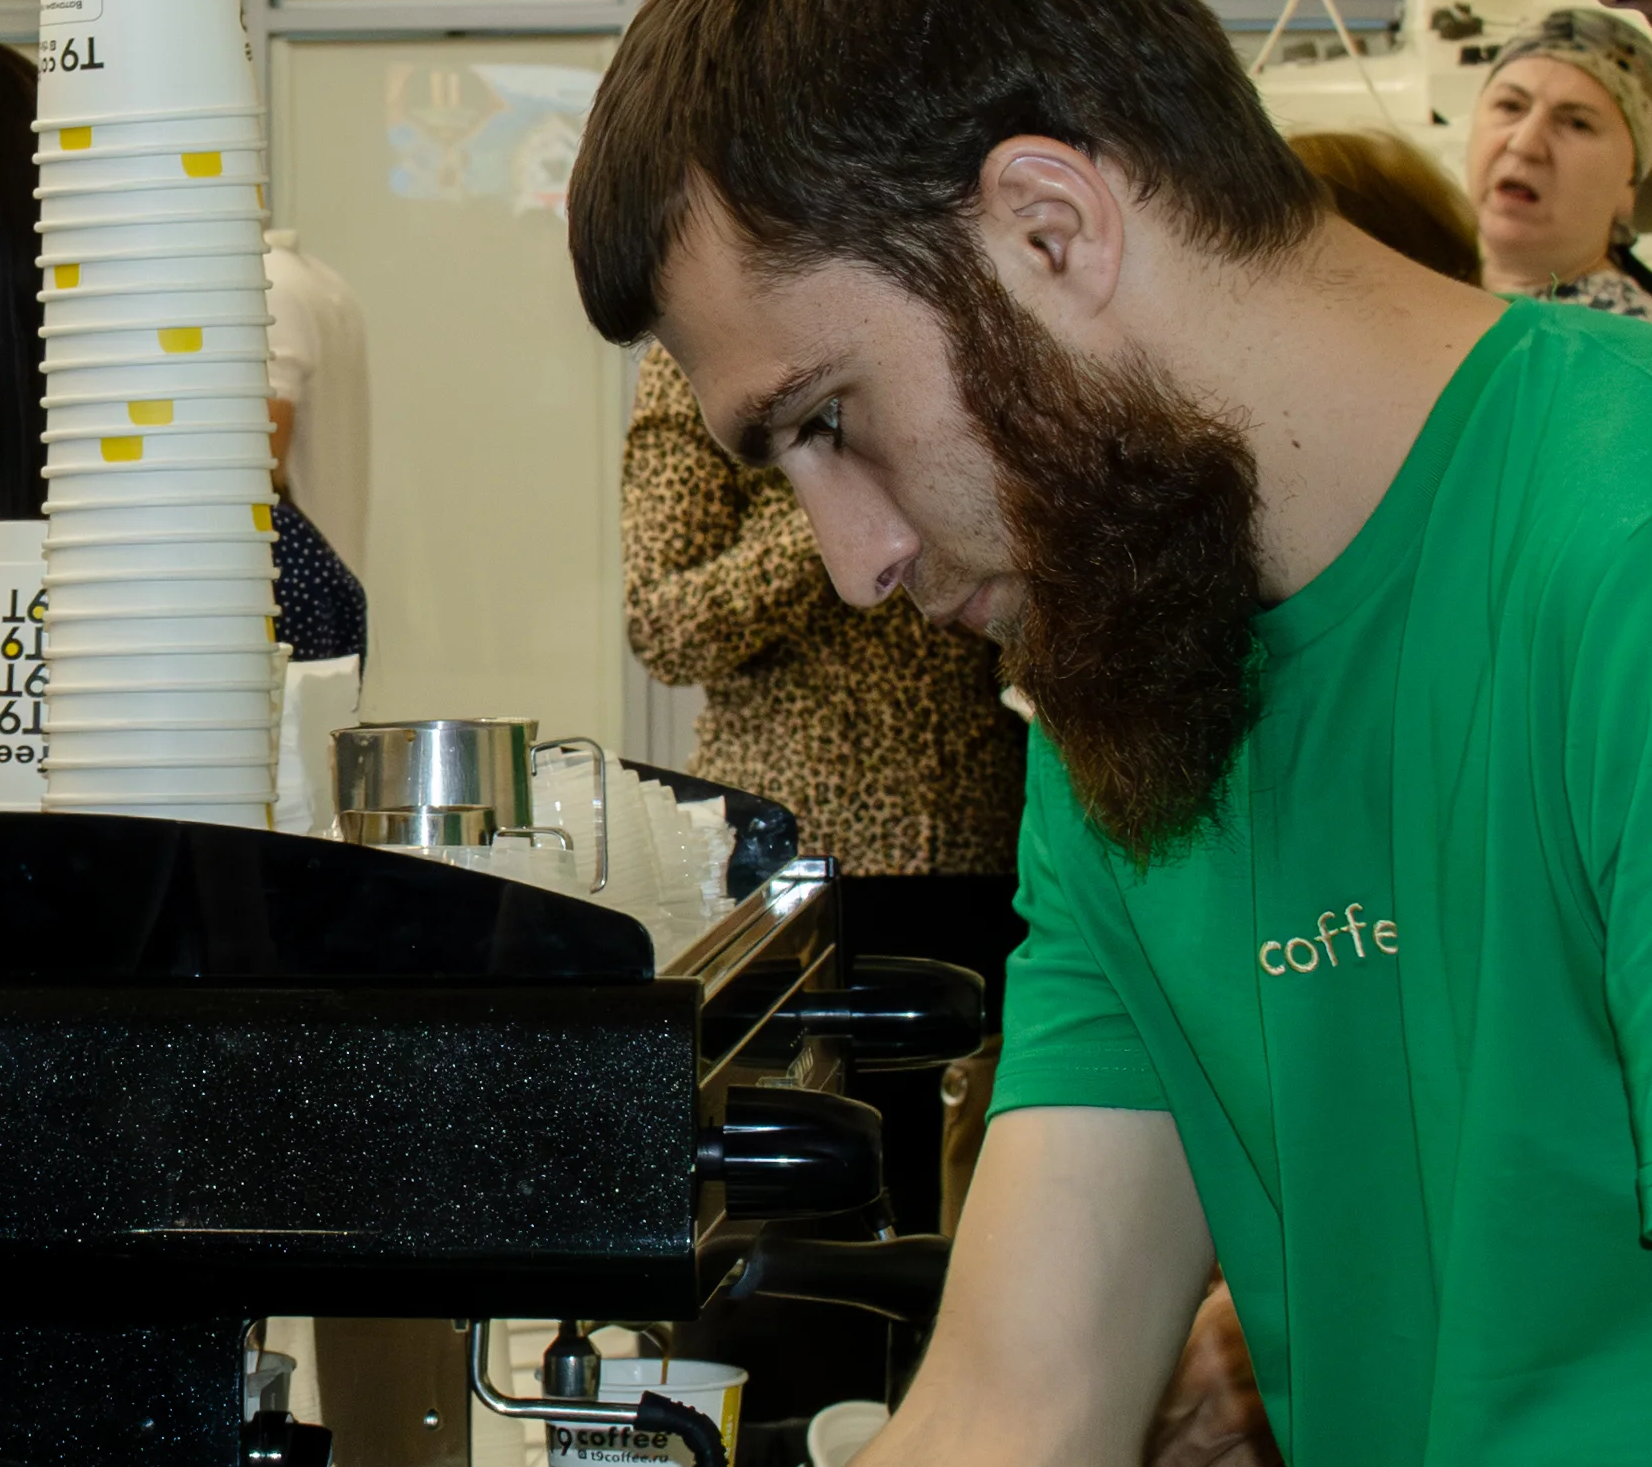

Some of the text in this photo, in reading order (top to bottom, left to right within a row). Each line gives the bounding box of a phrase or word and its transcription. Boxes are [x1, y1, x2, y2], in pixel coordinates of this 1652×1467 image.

[59, 36, 105, 73] T9
[576, 1425, 668, 1450] coffee
[590, 1449, 669, 1464] t9coffee.ru
